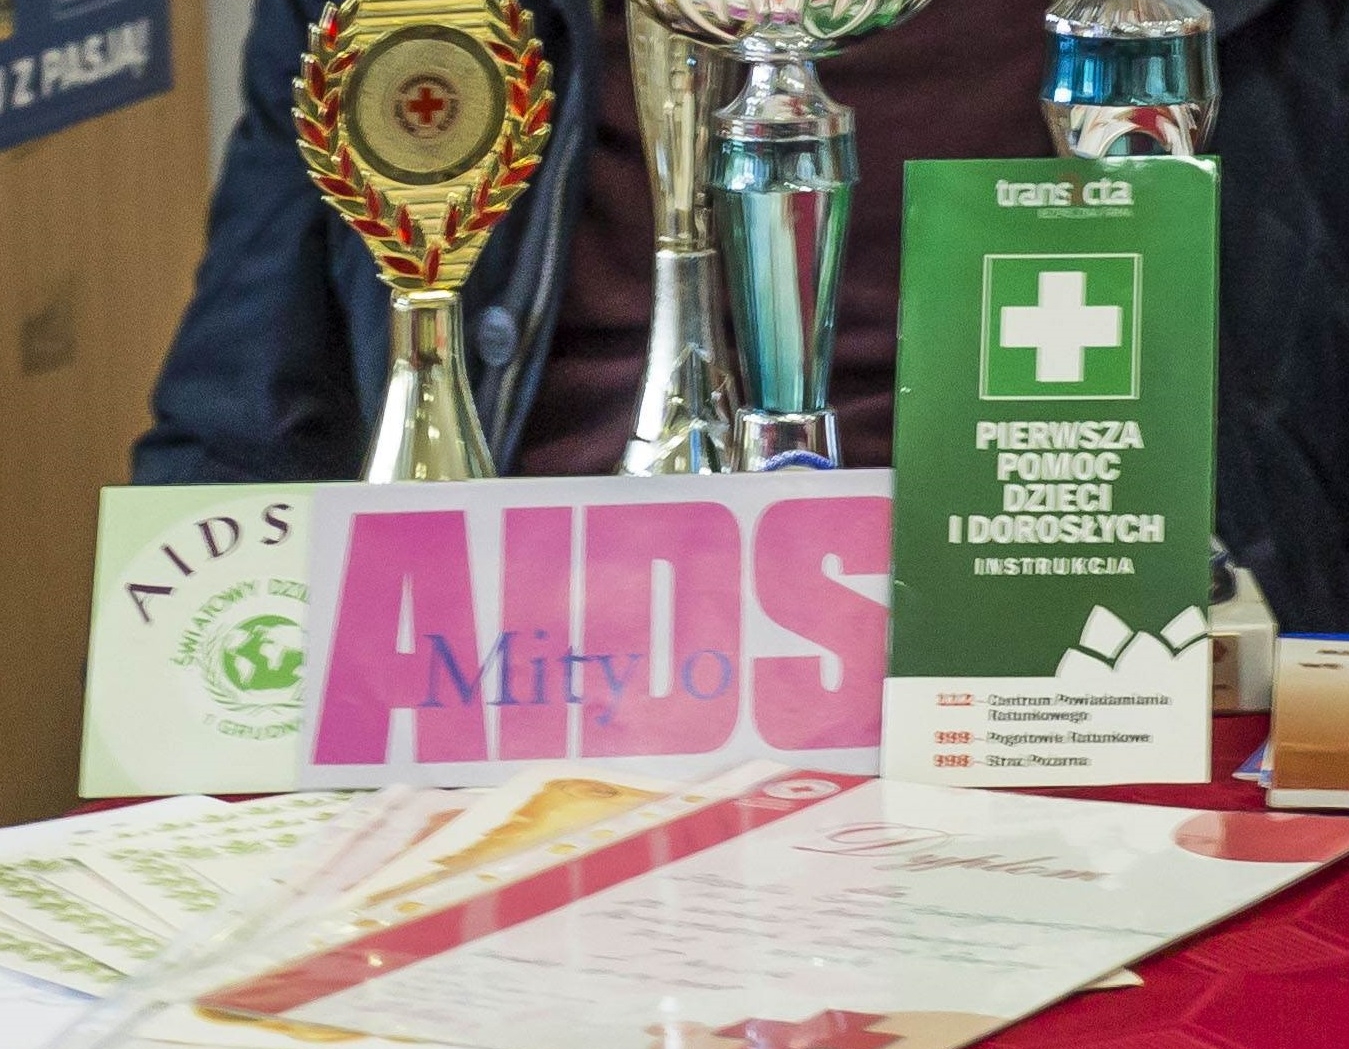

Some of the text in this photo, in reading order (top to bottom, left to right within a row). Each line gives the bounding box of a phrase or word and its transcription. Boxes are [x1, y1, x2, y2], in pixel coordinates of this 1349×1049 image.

[976, 420, 1145, 449] PIERWSZA
[997, 452, 1121, 481] POMOC
[1003, 483, 1113, 512] DZIECI
[948, 514, 1165, 544] I DOROSŁYCH
[125, 502, 294, 625] AIDS
[974, 556, 1135, 576] INSTRUKCJA
[310, 496, 892, 765] AIDS
[419, 629, 733, 726] Mity o
